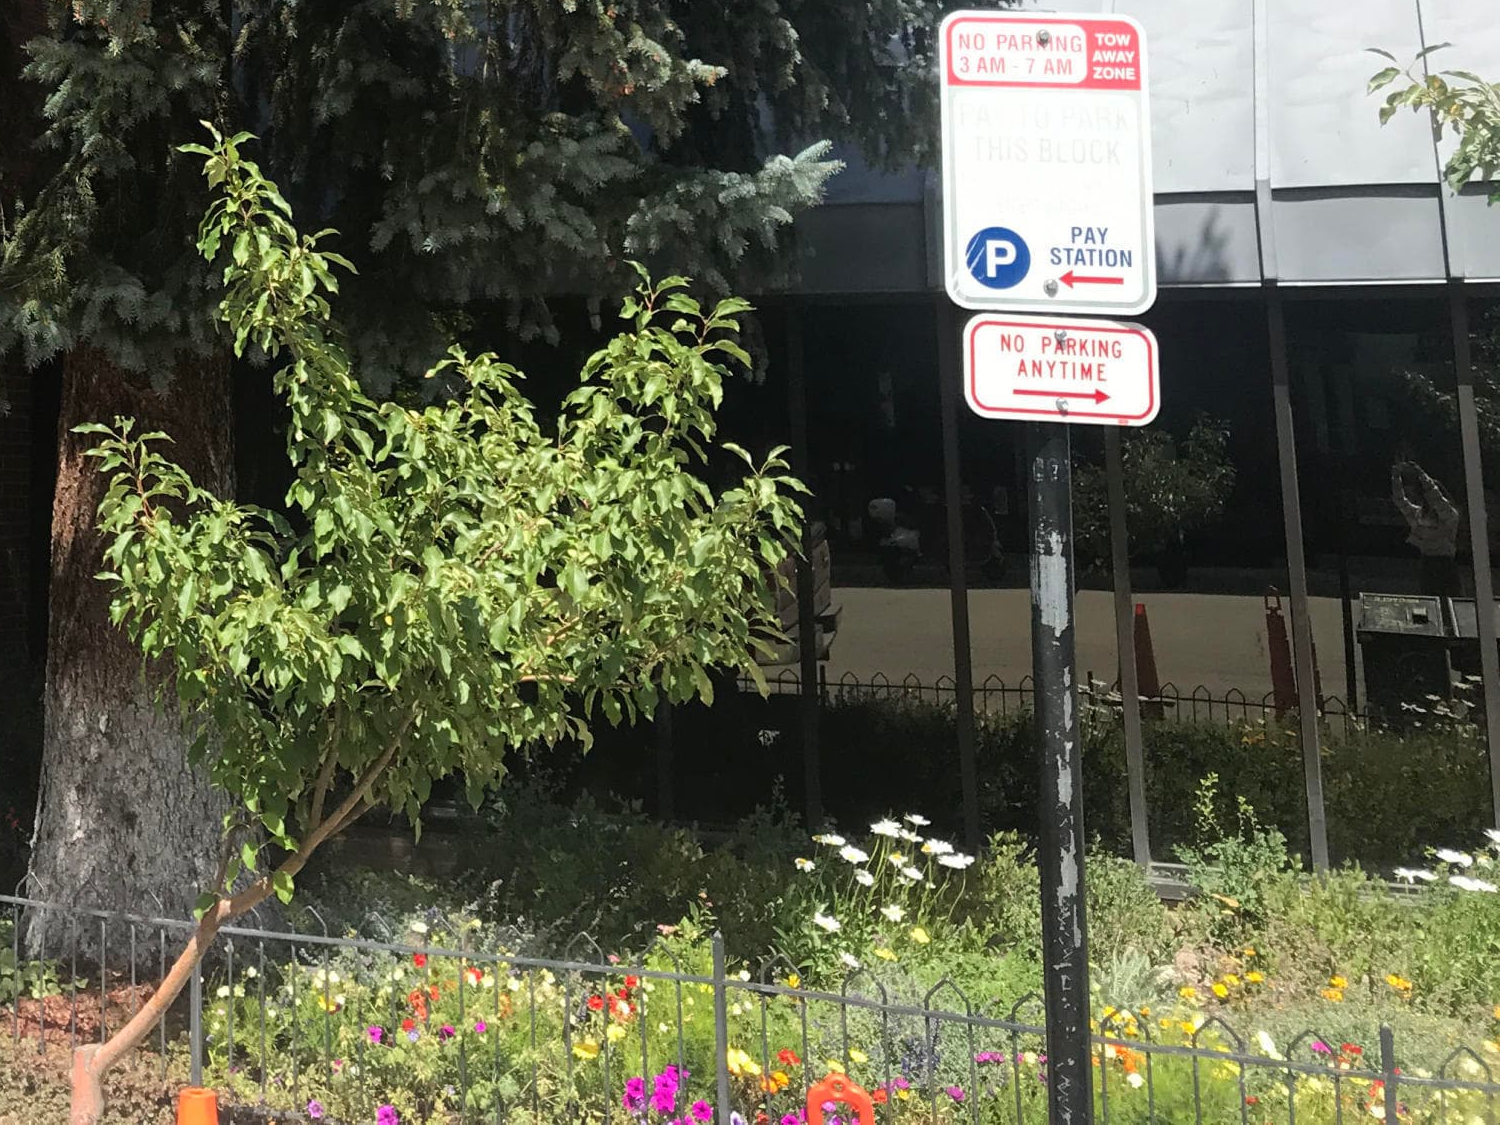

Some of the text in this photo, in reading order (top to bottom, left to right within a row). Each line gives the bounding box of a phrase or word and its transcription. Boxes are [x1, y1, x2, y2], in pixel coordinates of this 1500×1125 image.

[958, 33, 985, 51] NO
[1095, 33, 1131, 46] TOW
[959, 56, 970, 73] 3
[977, 57, 1006, 74] AM
[1026, 58, 1036, 74] 7
[1044, 59, 1073, 75] AM
[1092, 51, 1136, 63] AWAY
[1093, 67, 1136, 81] ZONE
[974, 136, 1121, 165] THIS BLOCK
[1071, 227, 1108, 245] PAY
[986, 239, 1017, 278] P
[1050, 248, 1132, 268] STATION
[1000, 334, 1122, 359] NO PARKING
[1017, 359, 1107, 381] ANYTIME
